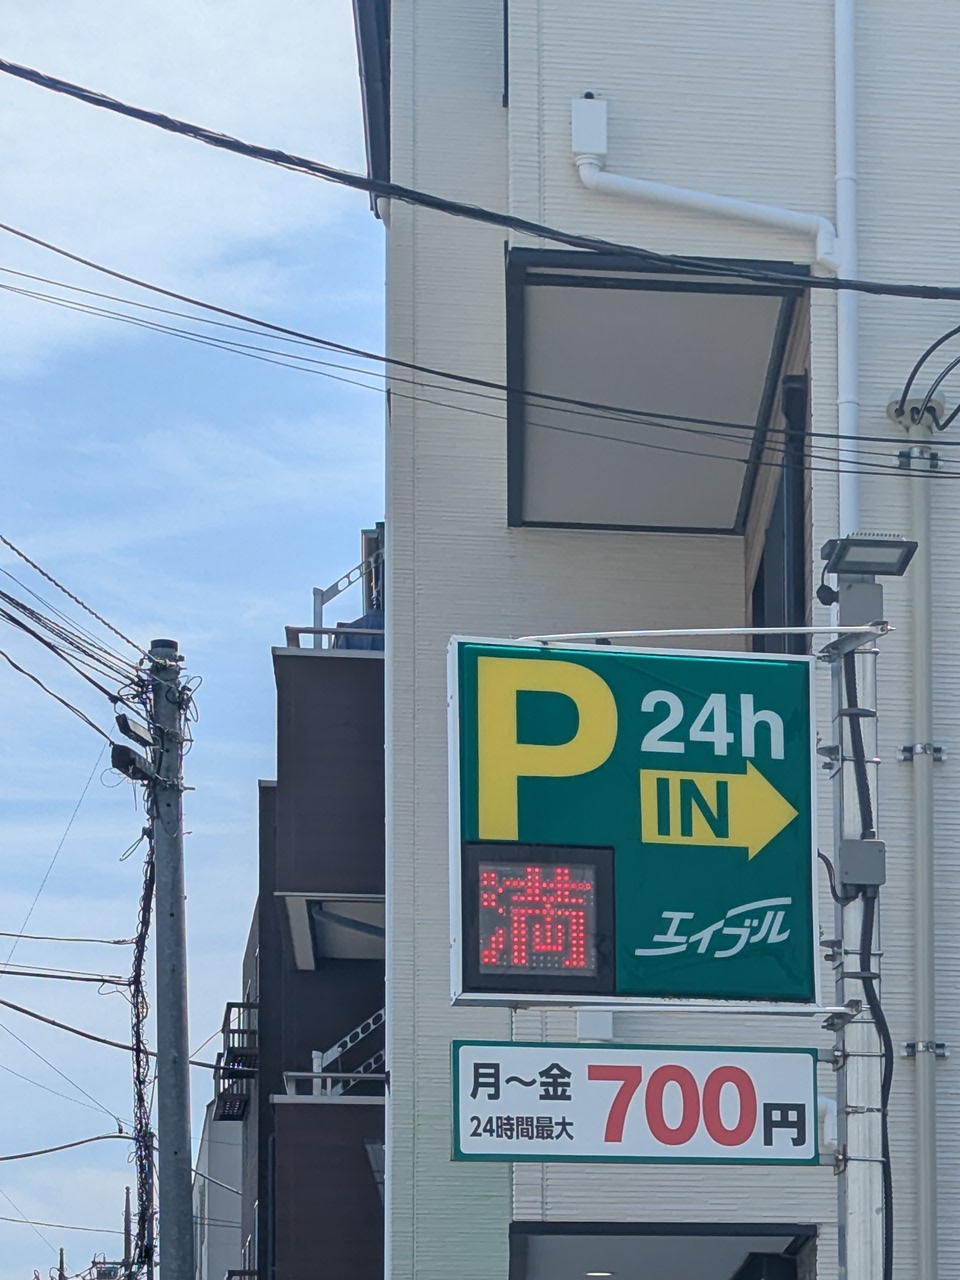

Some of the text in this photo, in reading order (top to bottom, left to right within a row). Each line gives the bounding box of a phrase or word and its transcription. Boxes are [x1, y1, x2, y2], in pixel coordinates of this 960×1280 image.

[477, 656, 618, 840] P
[640, 690, 785, 760] 24h
[656, 777, 729, 839] IN
[481, 867, 592, 967] 満
[635, 896, 792, 958] エイブル
[470, 1115, 574, 1141] 24時間最大
